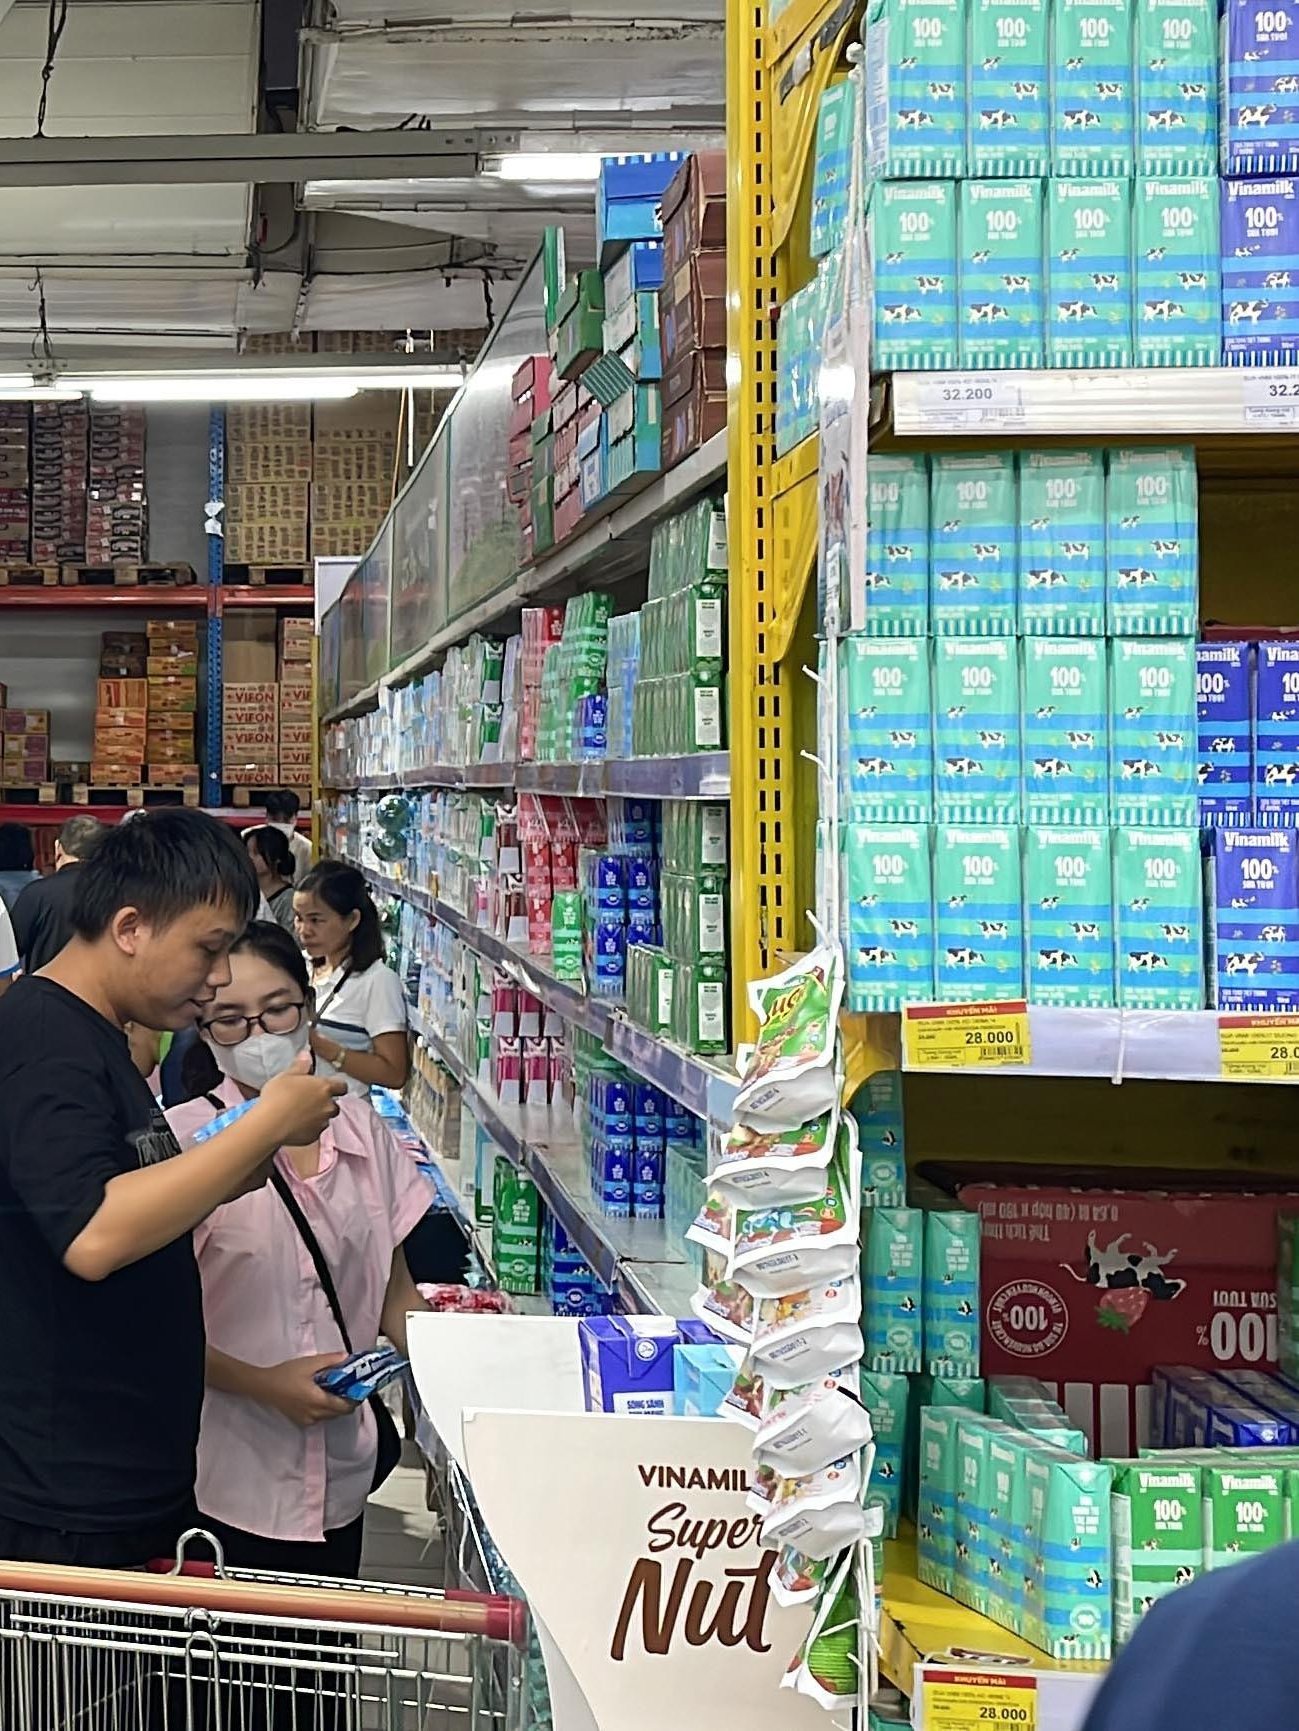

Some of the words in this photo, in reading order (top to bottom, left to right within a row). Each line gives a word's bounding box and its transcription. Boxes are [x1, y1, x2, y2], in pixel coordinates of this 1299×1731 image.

[1228, 179, 1295, 196] Vinamilk
[943, 388, 993, 401] 32.200
[1269, 384, 1299, 397] 32.2
[1196, 647, 1240, 661] namilk
[1267, 647, 1299, 661] Vina
[1282, 672, 1299, 693] 10
[235, 693, 274, 703] VIFON
[235, 713, 274, 723] VIFON
[235, 733, 274, 744] VIFON
[235, 773, 274, 783] VIFON
[1224, 832, 1289, 848] Vinamilk
[965, 1031, 1014, 1045] 28.000
[1270, 1046, 1299, 1059] 28.0
[638, 1465, 751, 1490] VINAMIL
[647, 1502, 763, 1559] Super
[610, 1550, 779, 1661] Nut
[979, 1706, 1027, 1721] 28.000
